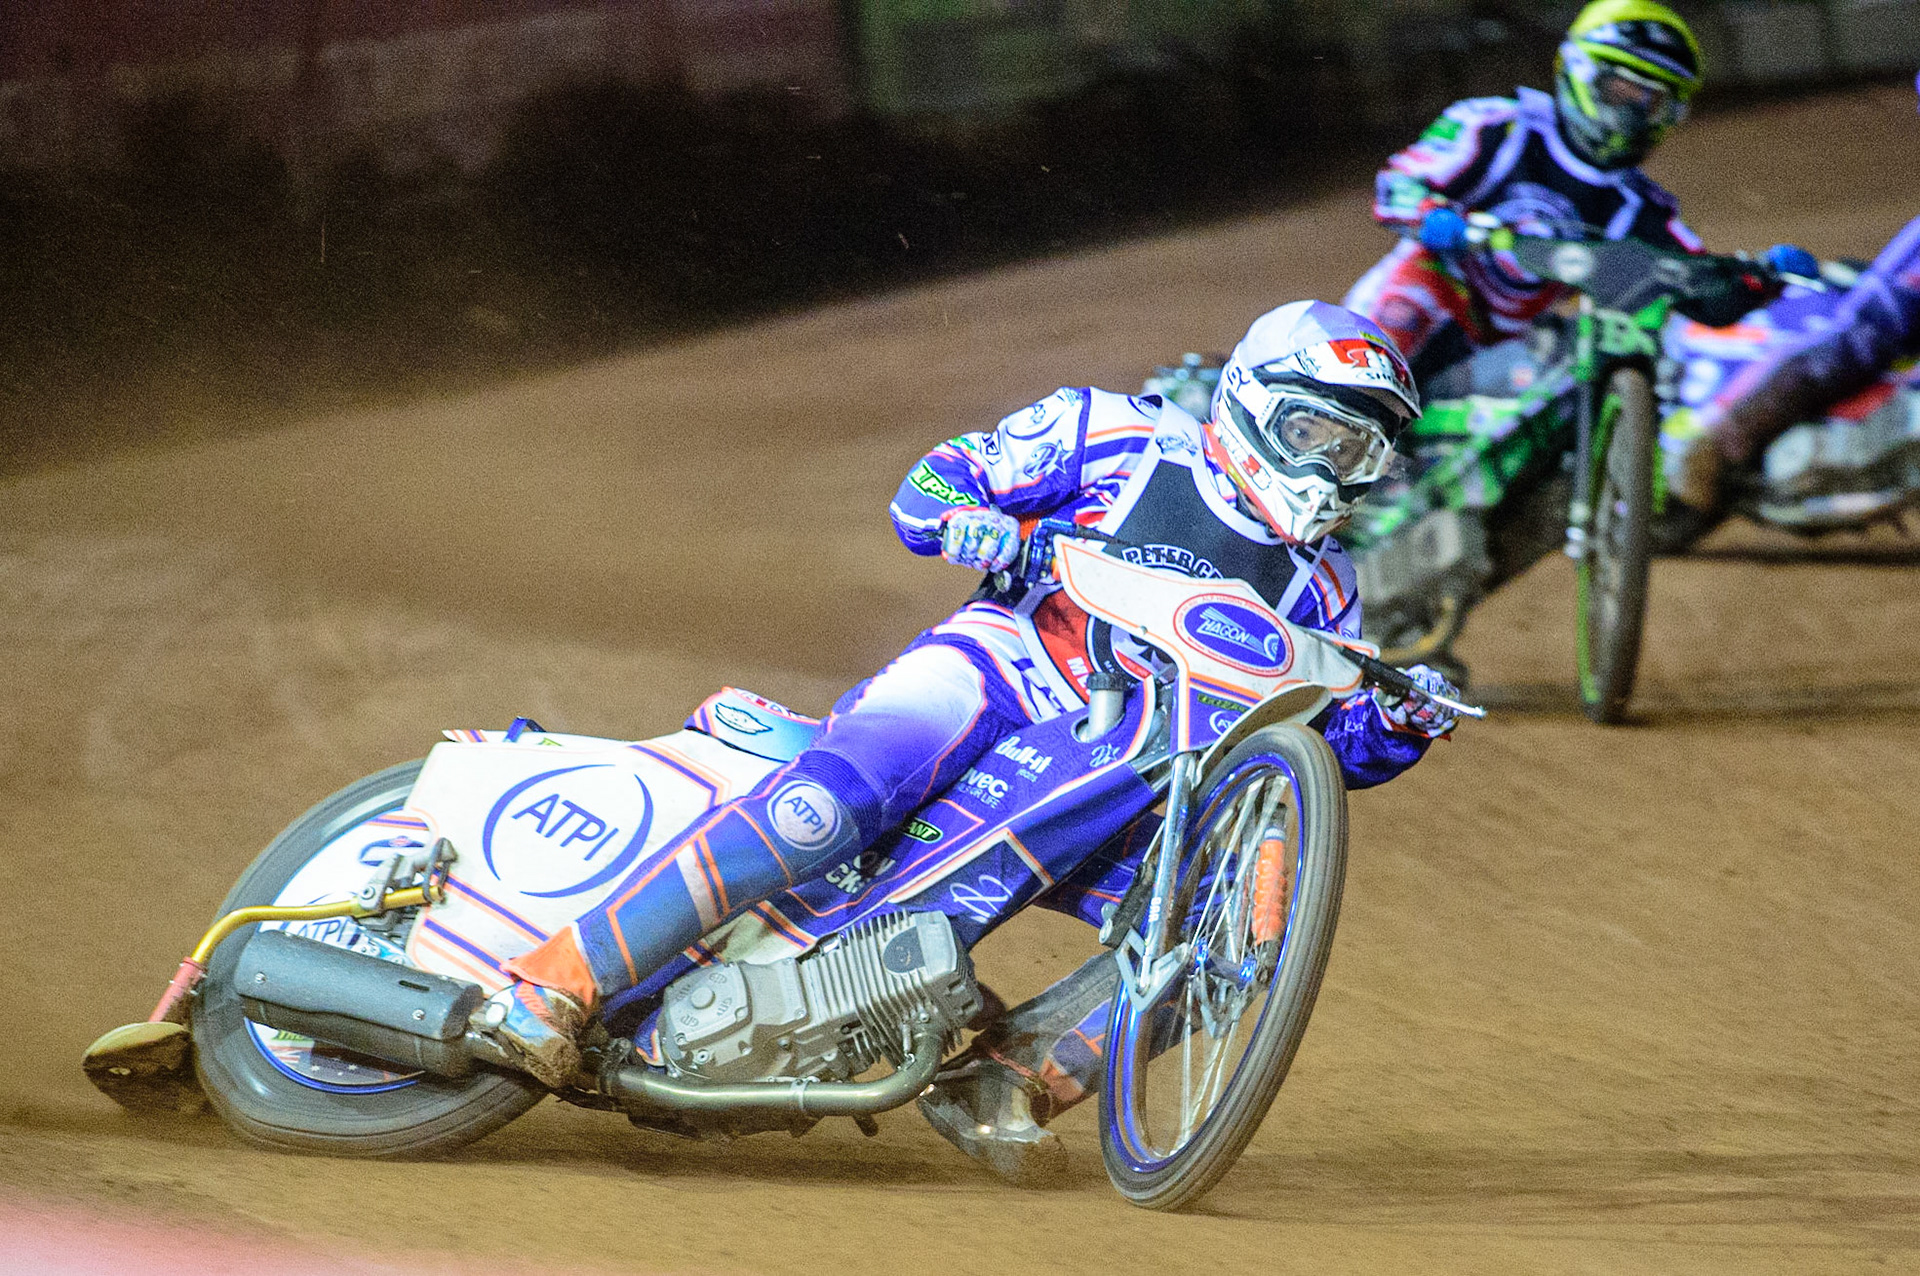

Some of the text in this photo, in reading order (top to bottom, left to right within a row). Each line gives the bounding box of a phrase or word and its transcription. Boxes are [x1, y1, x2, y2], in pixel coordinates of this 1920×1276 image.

[1122, 543, 1195, 573] PETER
[1202, 617, 1251, 644] HAGON
[510, 793, 620, 862] ATPI
[783, 795, 827, 836] ATPI
